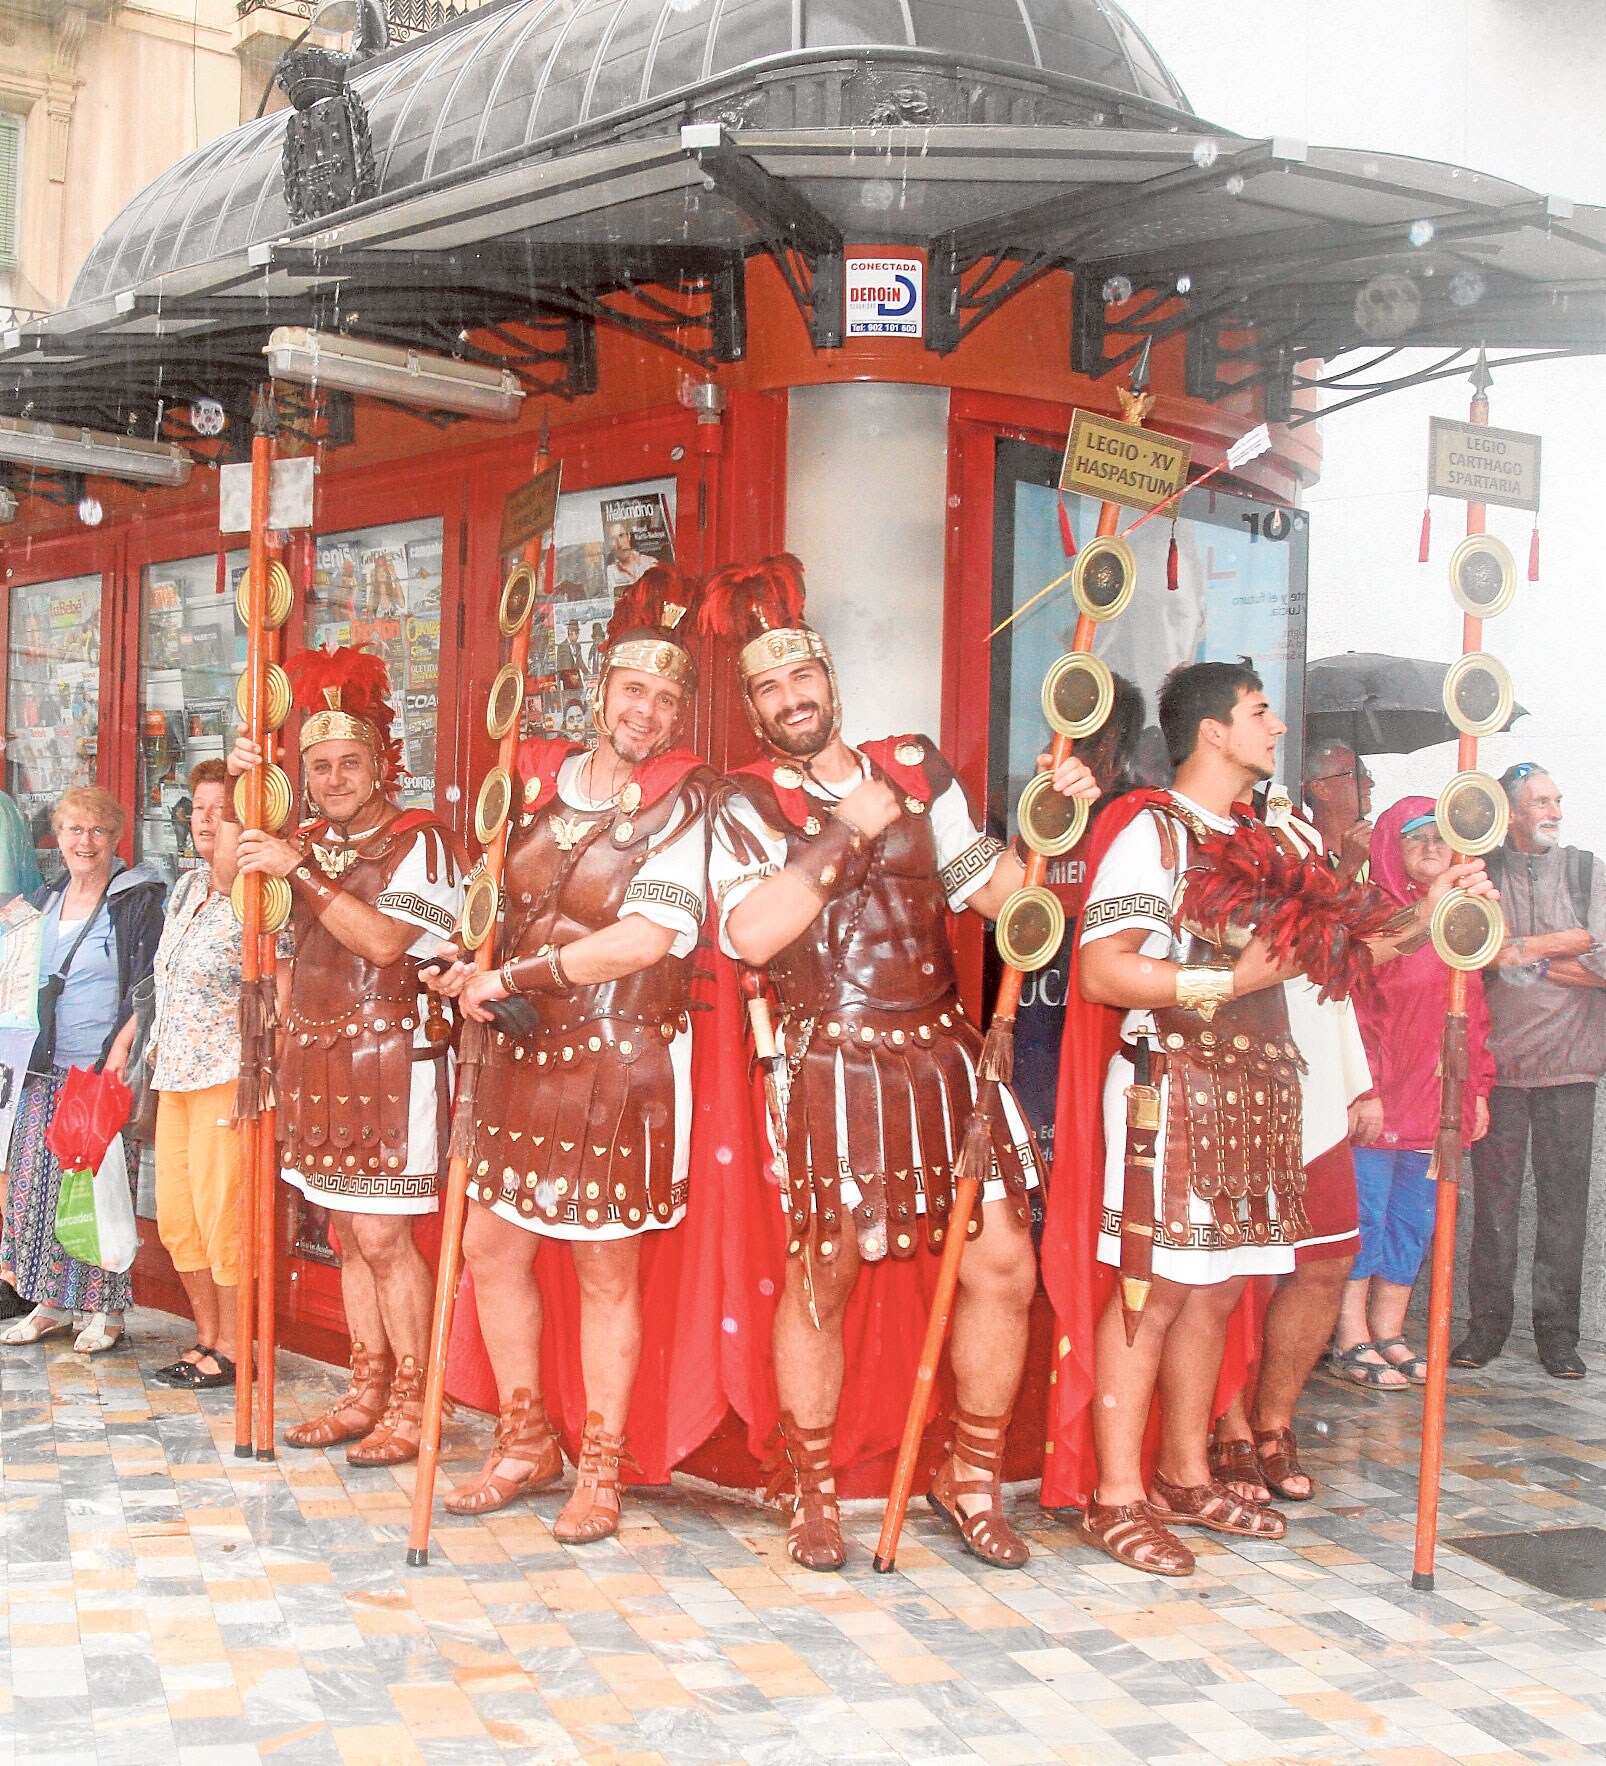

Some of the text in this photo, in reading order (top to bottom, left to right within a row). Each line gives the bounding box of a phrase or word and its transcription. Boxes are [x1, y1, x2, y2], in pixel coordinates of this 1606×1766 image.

[851, 263, 917, 271] CONECTADA
[867, 324, 883, 332] 902
[885, 324, 899, 333] 101
[1086, 432, 1176, 471] LEGIO XV
[1466, 436, 1507, 455] LEGIO
[1448, 452, 1523, 476] CARTHAGO
[1075, 455, 1175, 498] HASPASTUM
[1448, 470, 1521, 495] SPARTARIA
